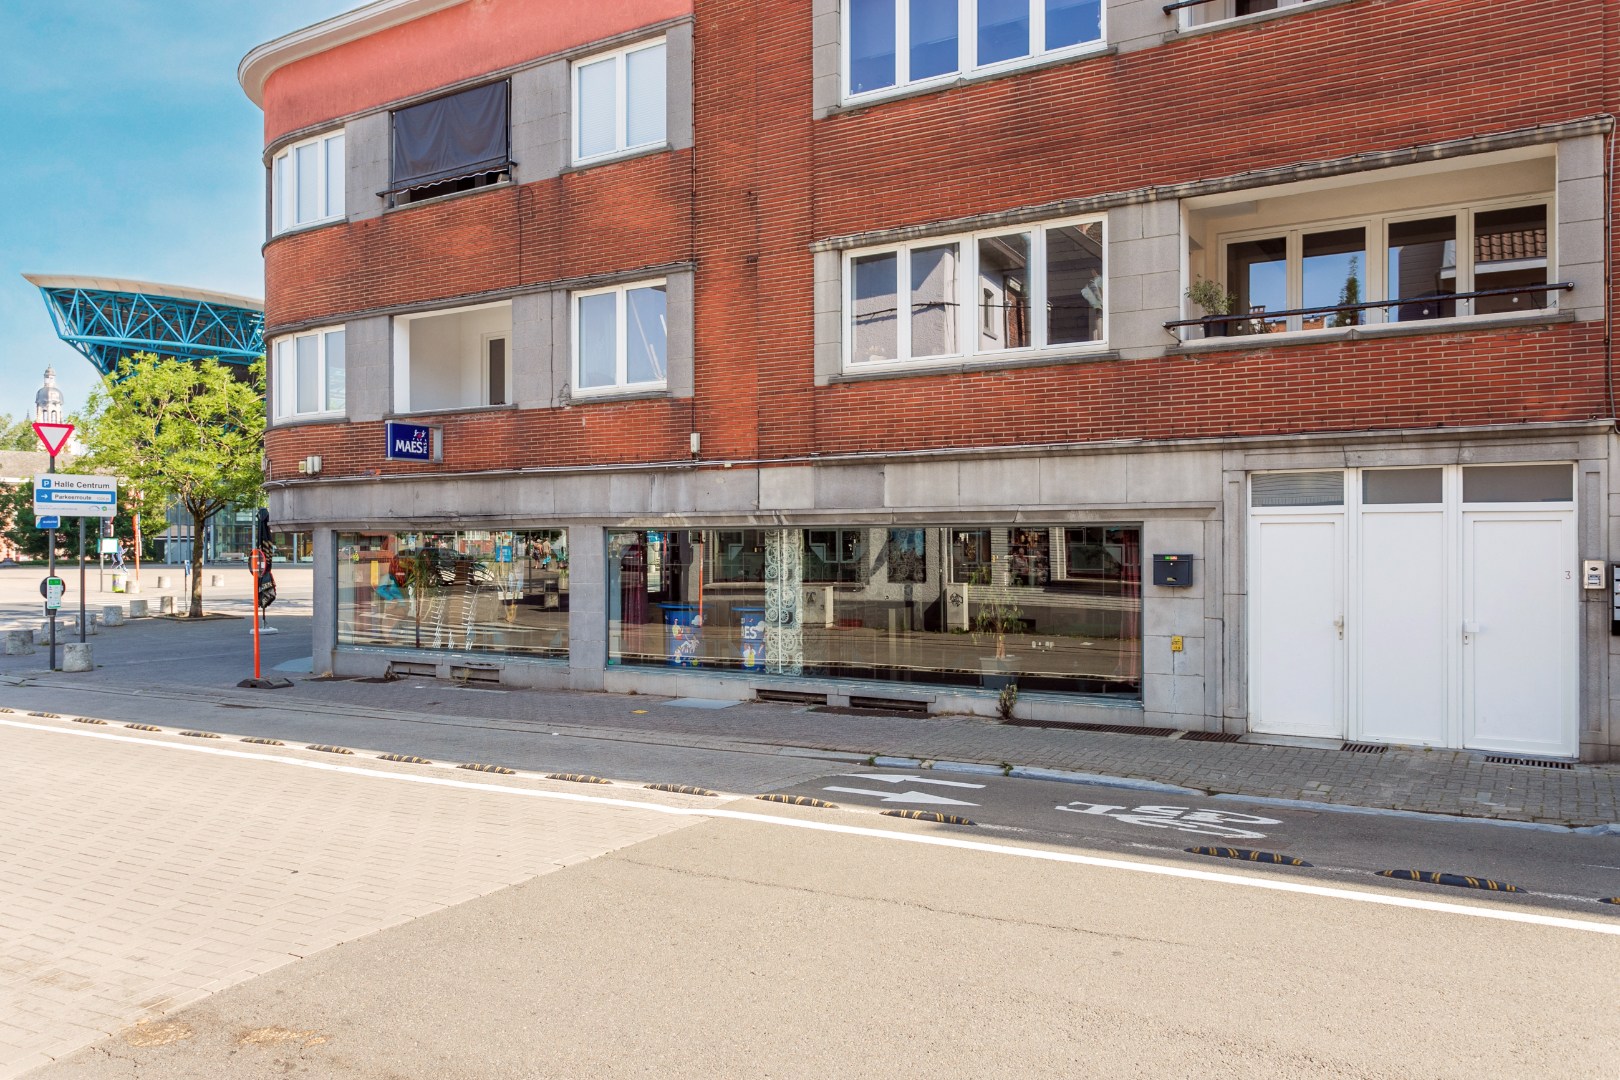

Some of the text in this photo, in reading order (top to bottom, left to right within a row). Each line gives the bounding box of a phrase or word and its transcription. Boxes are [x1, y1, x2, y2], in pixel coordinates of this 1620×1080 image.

[395, 440, 423, 453] MAES
[76, 481, 110, 489] Centrum
[1565, 571, 1571, 580] 3
